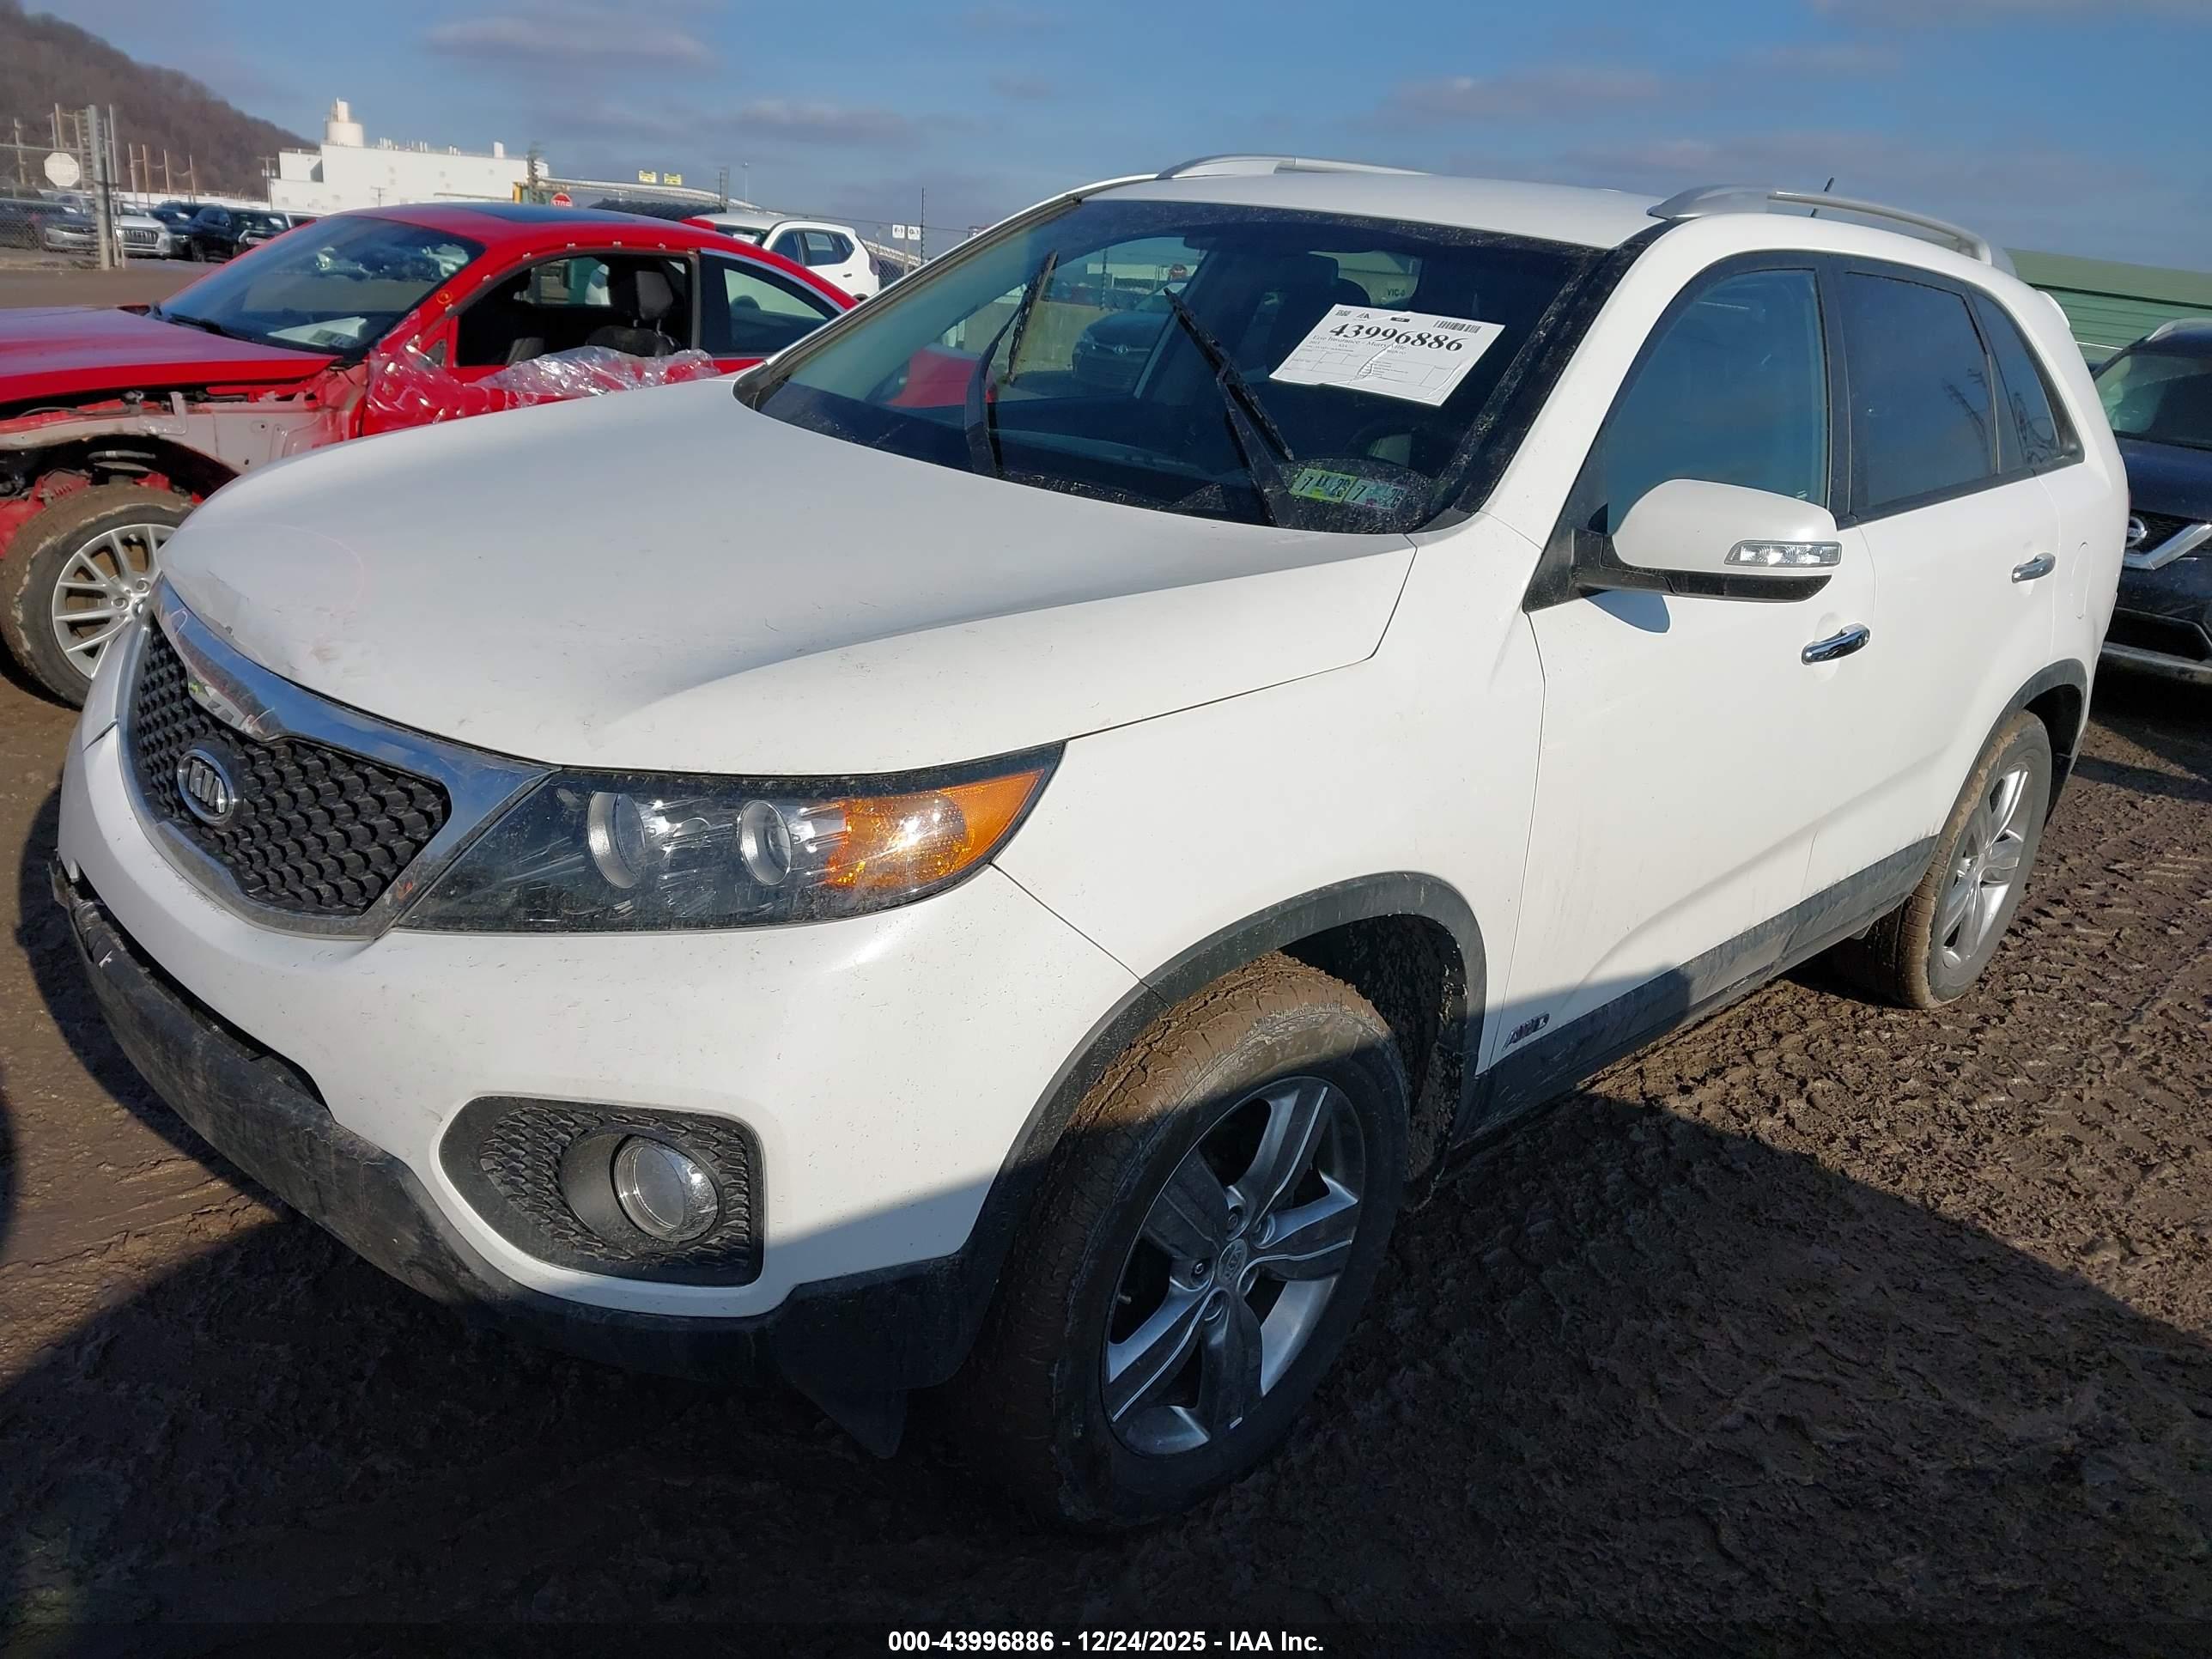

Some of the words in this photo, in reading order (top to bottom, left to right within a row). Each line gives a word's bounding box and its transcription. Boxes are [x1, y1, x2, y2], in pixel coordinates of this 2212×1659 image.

[1329, 323, 1470, 351] 43996886
[1352, 484, 1368, 501] 7
[189, 759, 226, 814] KIA
